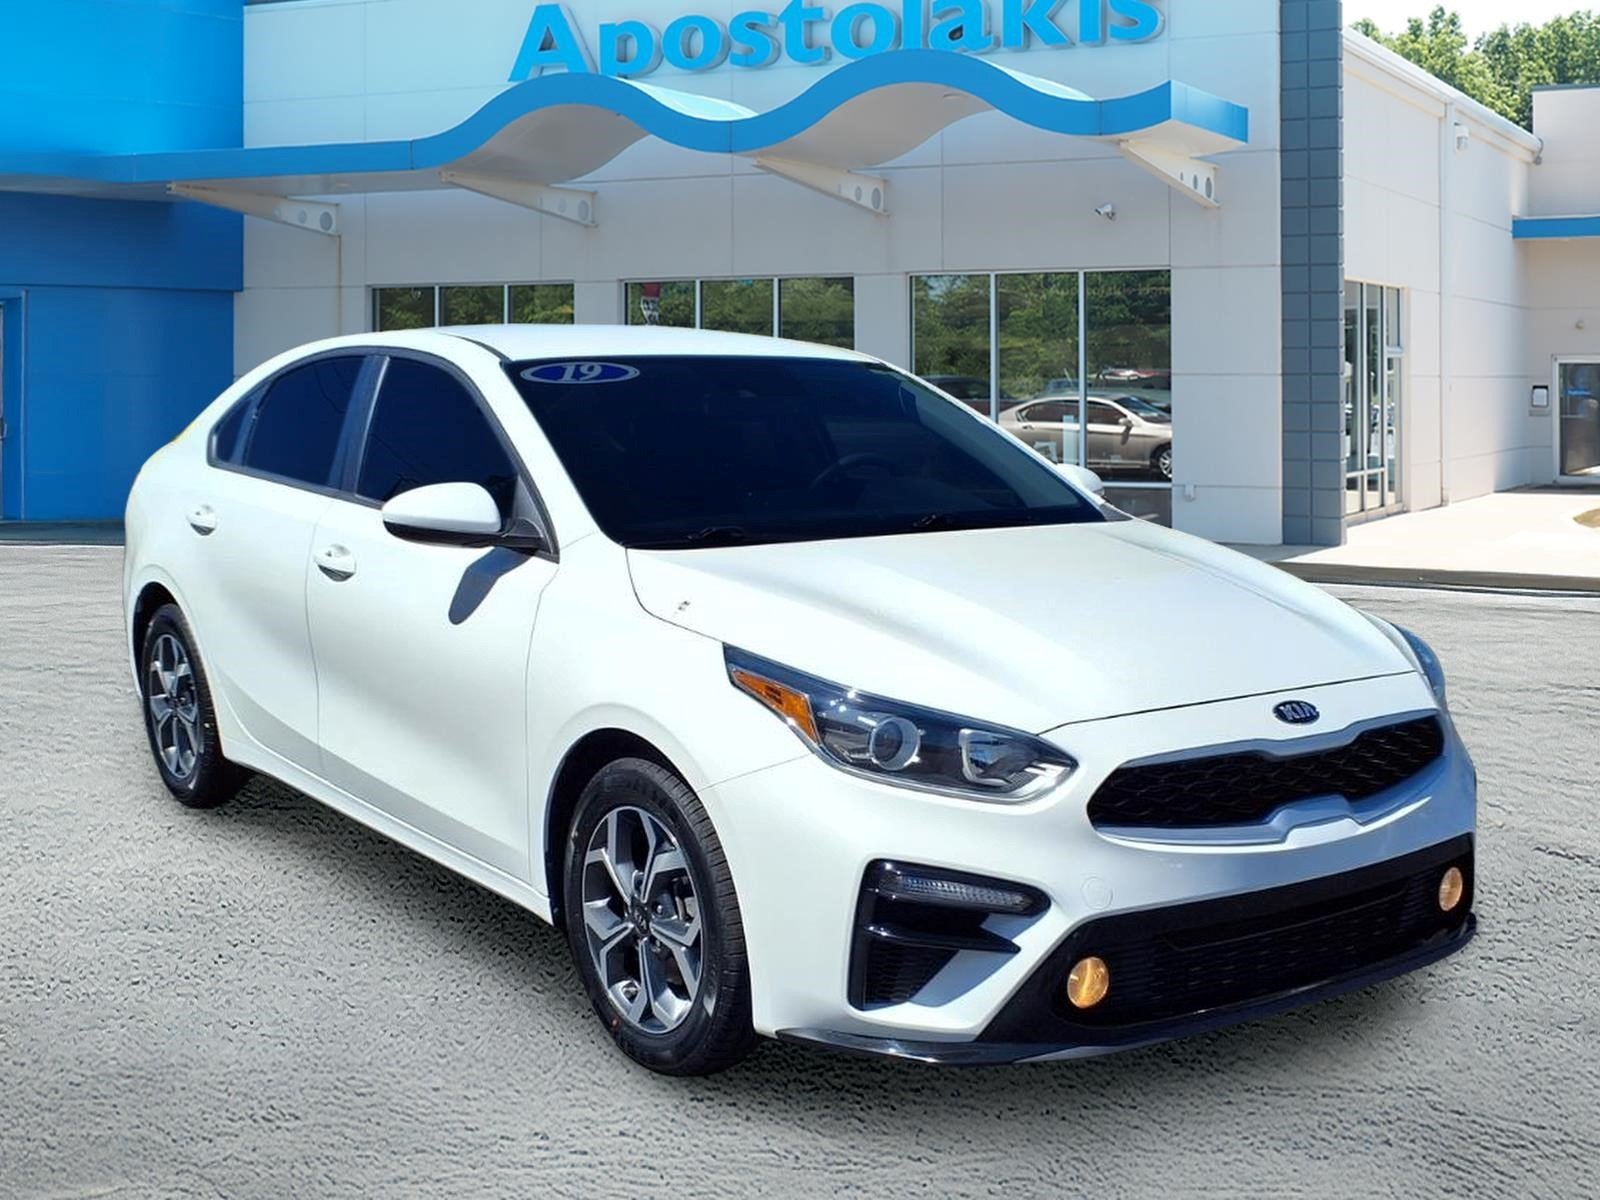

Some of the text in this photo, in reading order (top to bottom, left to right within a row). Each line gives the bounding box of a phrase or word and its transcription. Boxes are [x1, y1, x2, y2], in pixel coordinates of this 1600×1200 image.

[507, 0, 1162, 81] Apostolakis
[558, 363, 602, 381] 19
[1277, 702, 1317, 721] KIA
